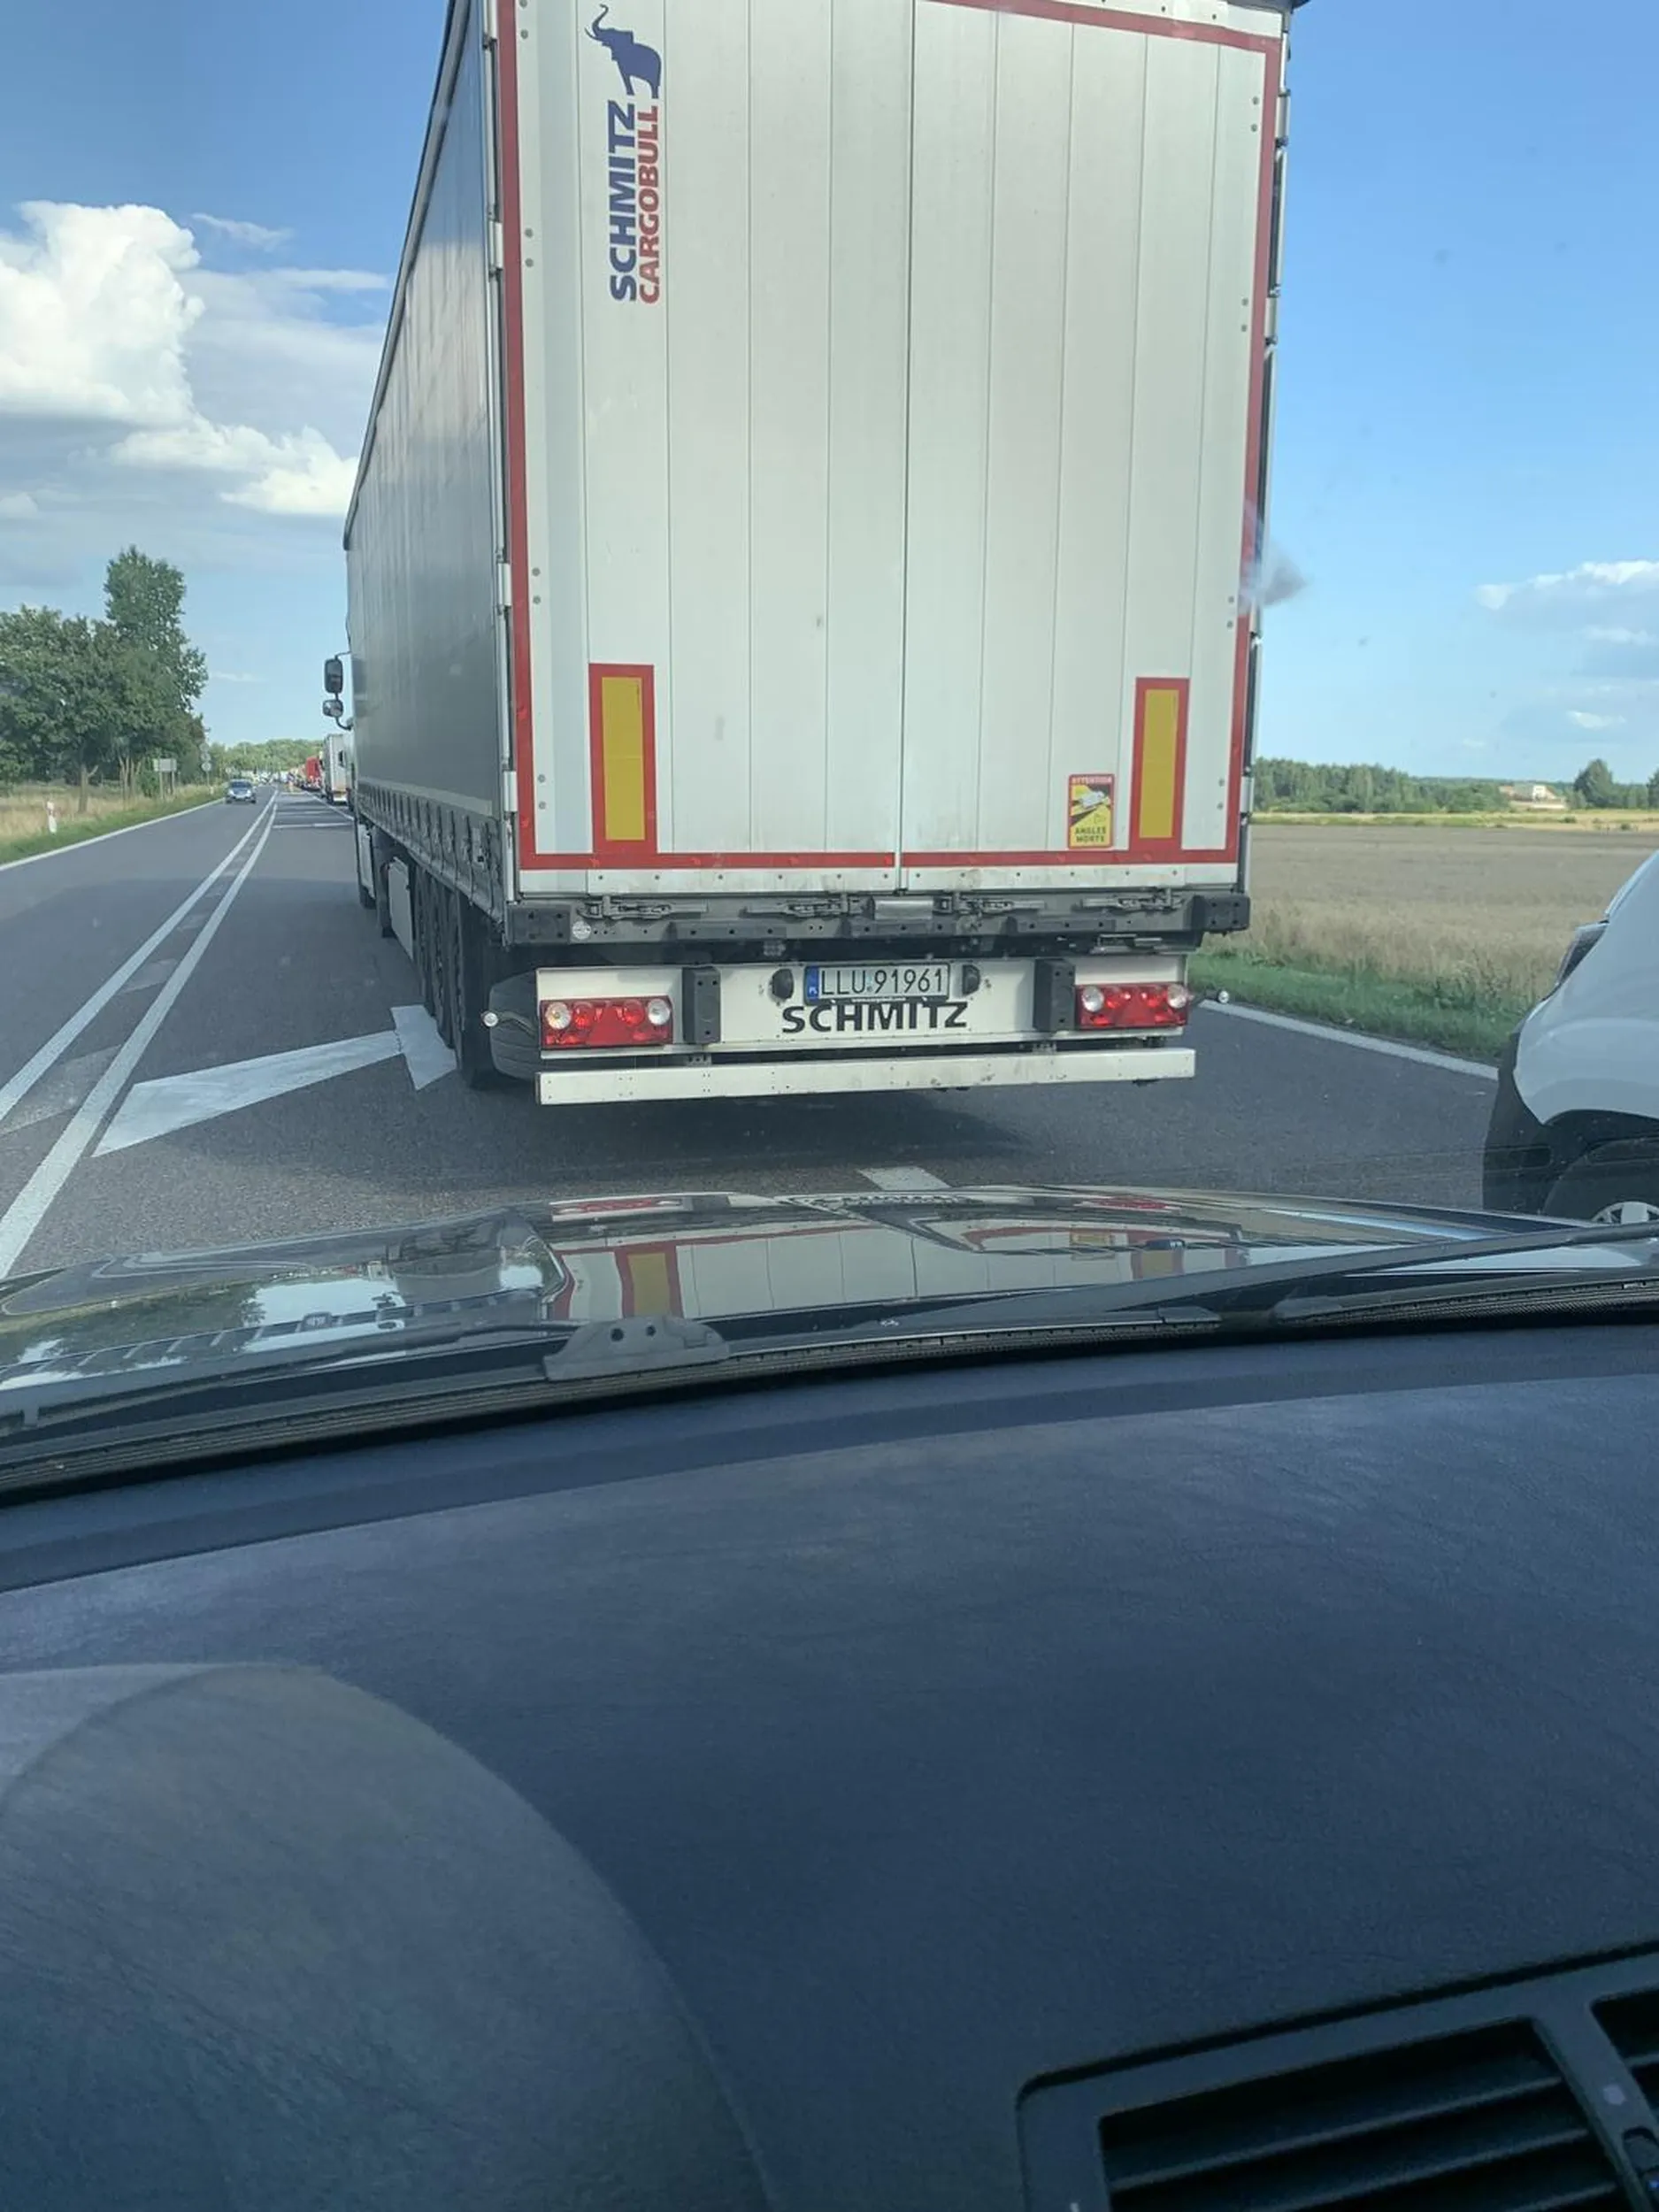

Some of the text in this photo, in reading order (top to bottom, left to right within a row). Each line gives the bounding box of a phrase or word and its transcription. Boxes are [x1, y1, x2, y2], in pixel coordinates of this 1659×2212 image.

[608, 100, 636, 302] SCHMITZ
[637, 105, 660, 304] CARGOBULL
[782, 1002, 968, 1033] SCHMITZ
